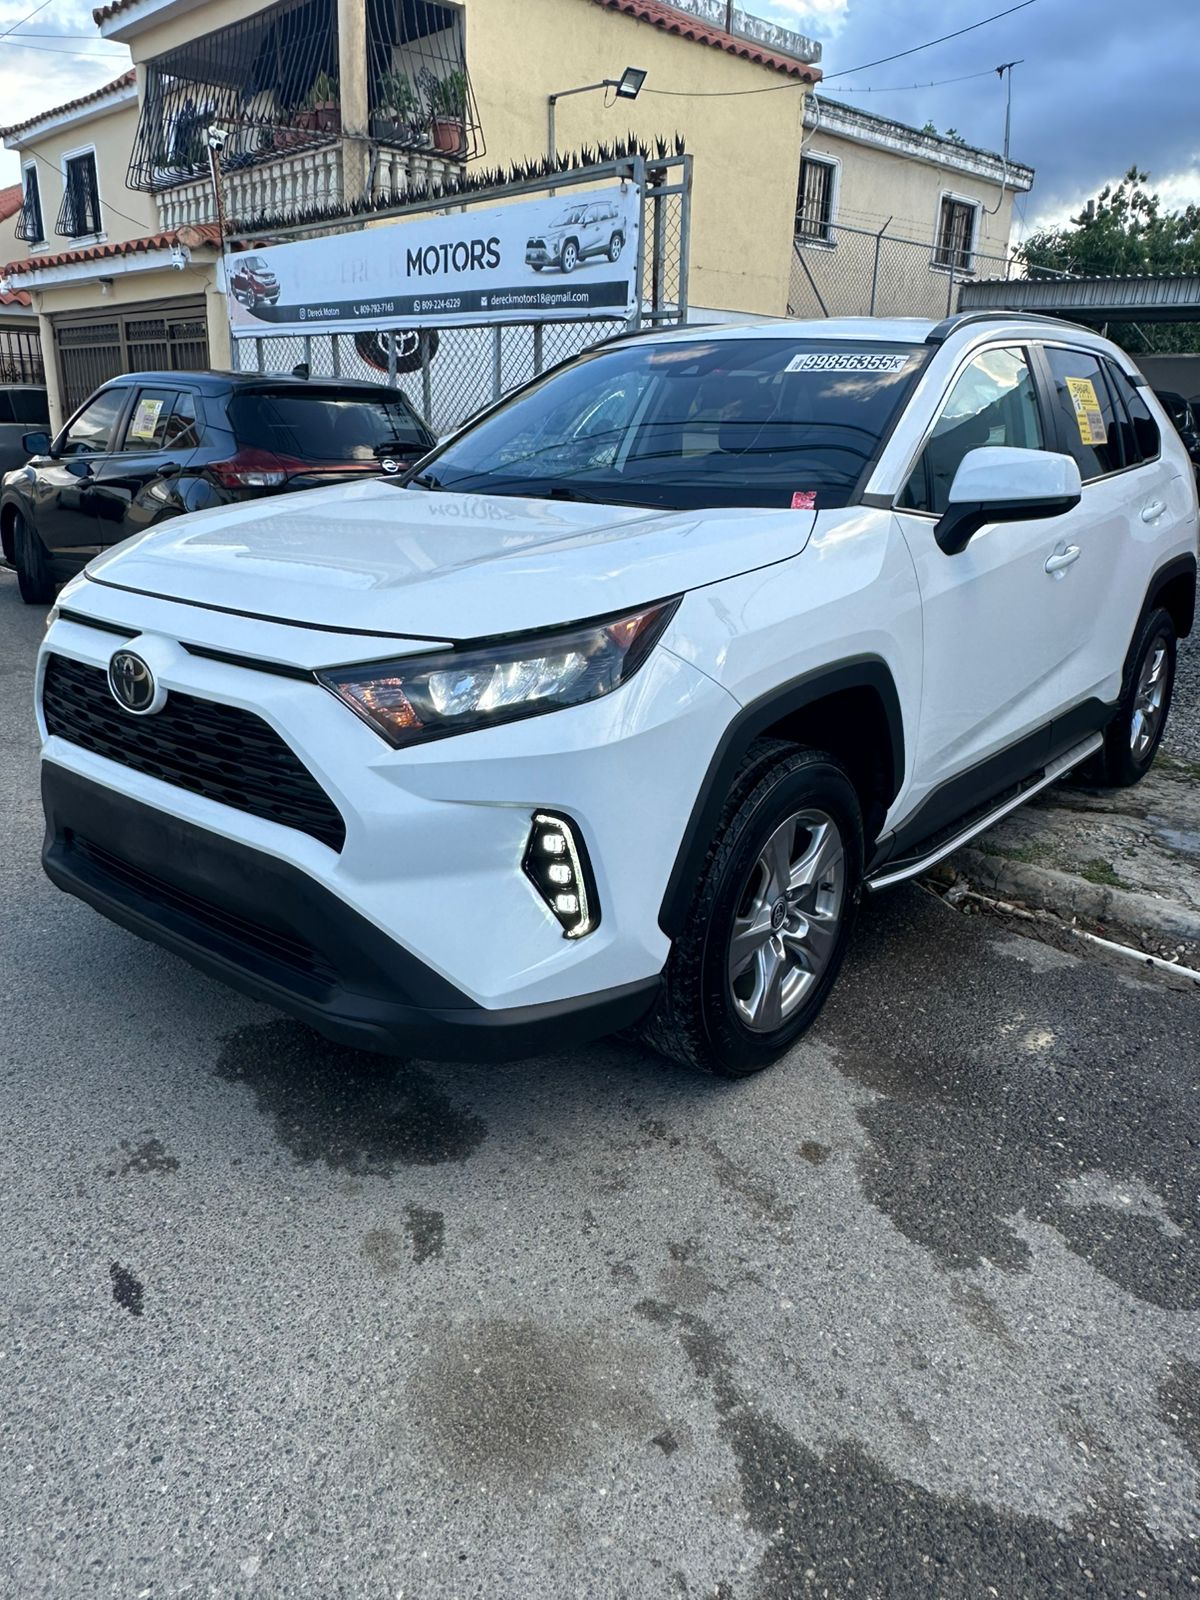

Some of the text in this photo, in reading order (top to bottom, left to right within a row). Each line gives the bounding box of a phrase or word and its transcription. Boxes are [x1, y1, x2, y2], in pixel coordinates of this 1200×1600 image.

[406, 236, 501, 277] MOTORS
[421, 298, 461, 310] 809-224-6229
[491, 291, 589, 305] dereckmotors18@gmail.com
